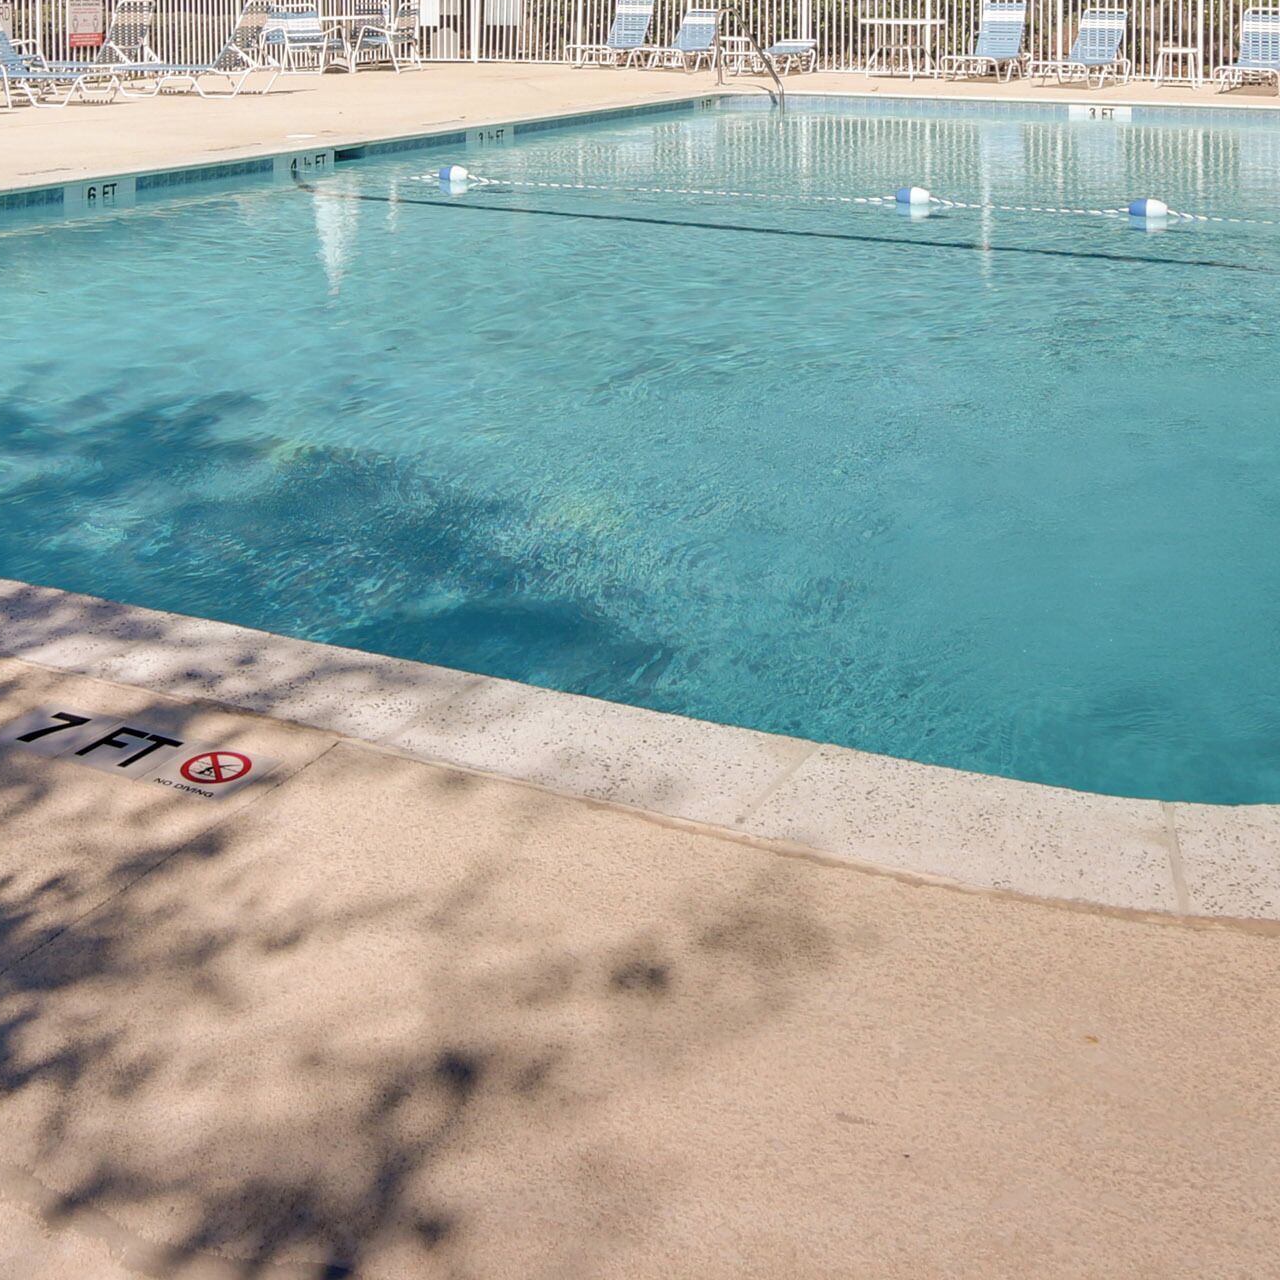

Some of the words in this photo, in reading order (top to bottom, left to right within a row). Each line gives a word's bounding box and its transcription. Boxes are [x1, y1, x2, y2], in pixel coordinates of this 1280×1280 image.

[1101, 107, 1115, 120] FT
[315, 154, 326, 168] FT
[87, 186, 96, 200] 6
[102, 183, 117, 197] FT
[16, 712, 92, 743] 7
[74, 727, 184, 768] FT
[153, 777, 173, 786] NO
[173, 783, 215, 798] DIVING
